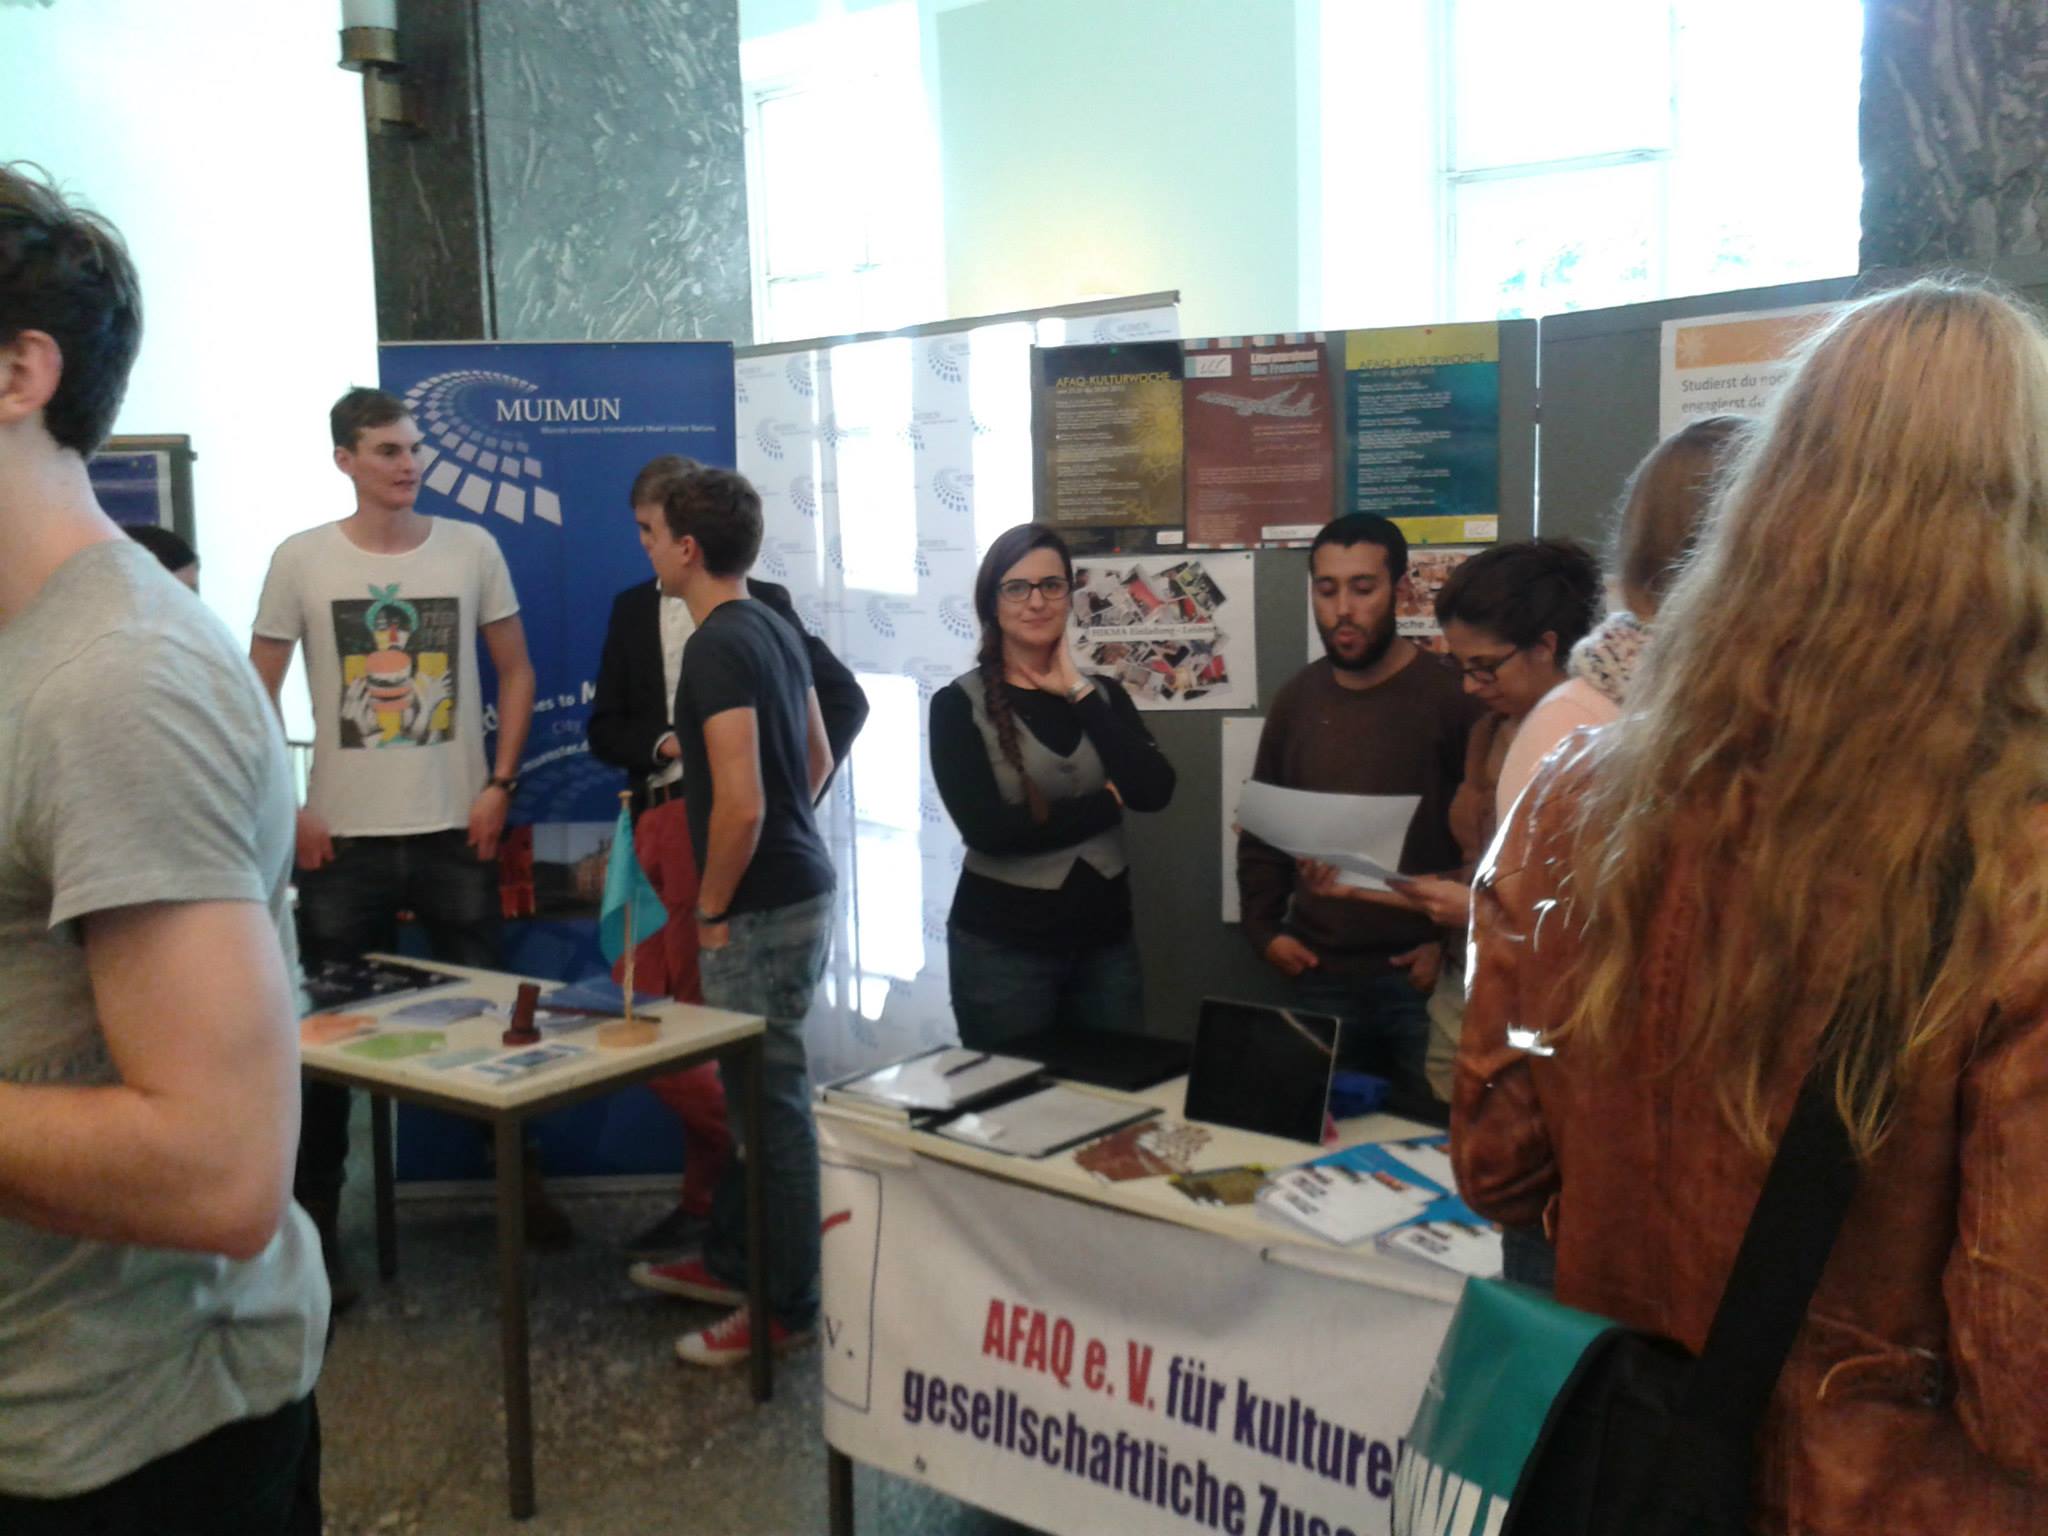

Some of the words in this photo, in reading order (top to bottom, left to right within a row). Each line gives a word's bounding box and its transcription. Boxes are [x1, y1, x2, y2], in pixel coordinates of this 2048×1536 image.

[496, 398, 620, 422] MUIMUN
[1681, 376, 1737, 392] Studierst
[1740, 374, 1757, 387] du
[982, 1298, 1074, 1390] AFAQ
[1084, 1338, 1114, 1396] e.
[1127, 1338, 1155, 1411] V.
[1167, 1356, 1227, 1432] für
[1234, 1377, 1404, 1500] kulture
[903, 1368, 1246, 1536] gesellschaftliche
